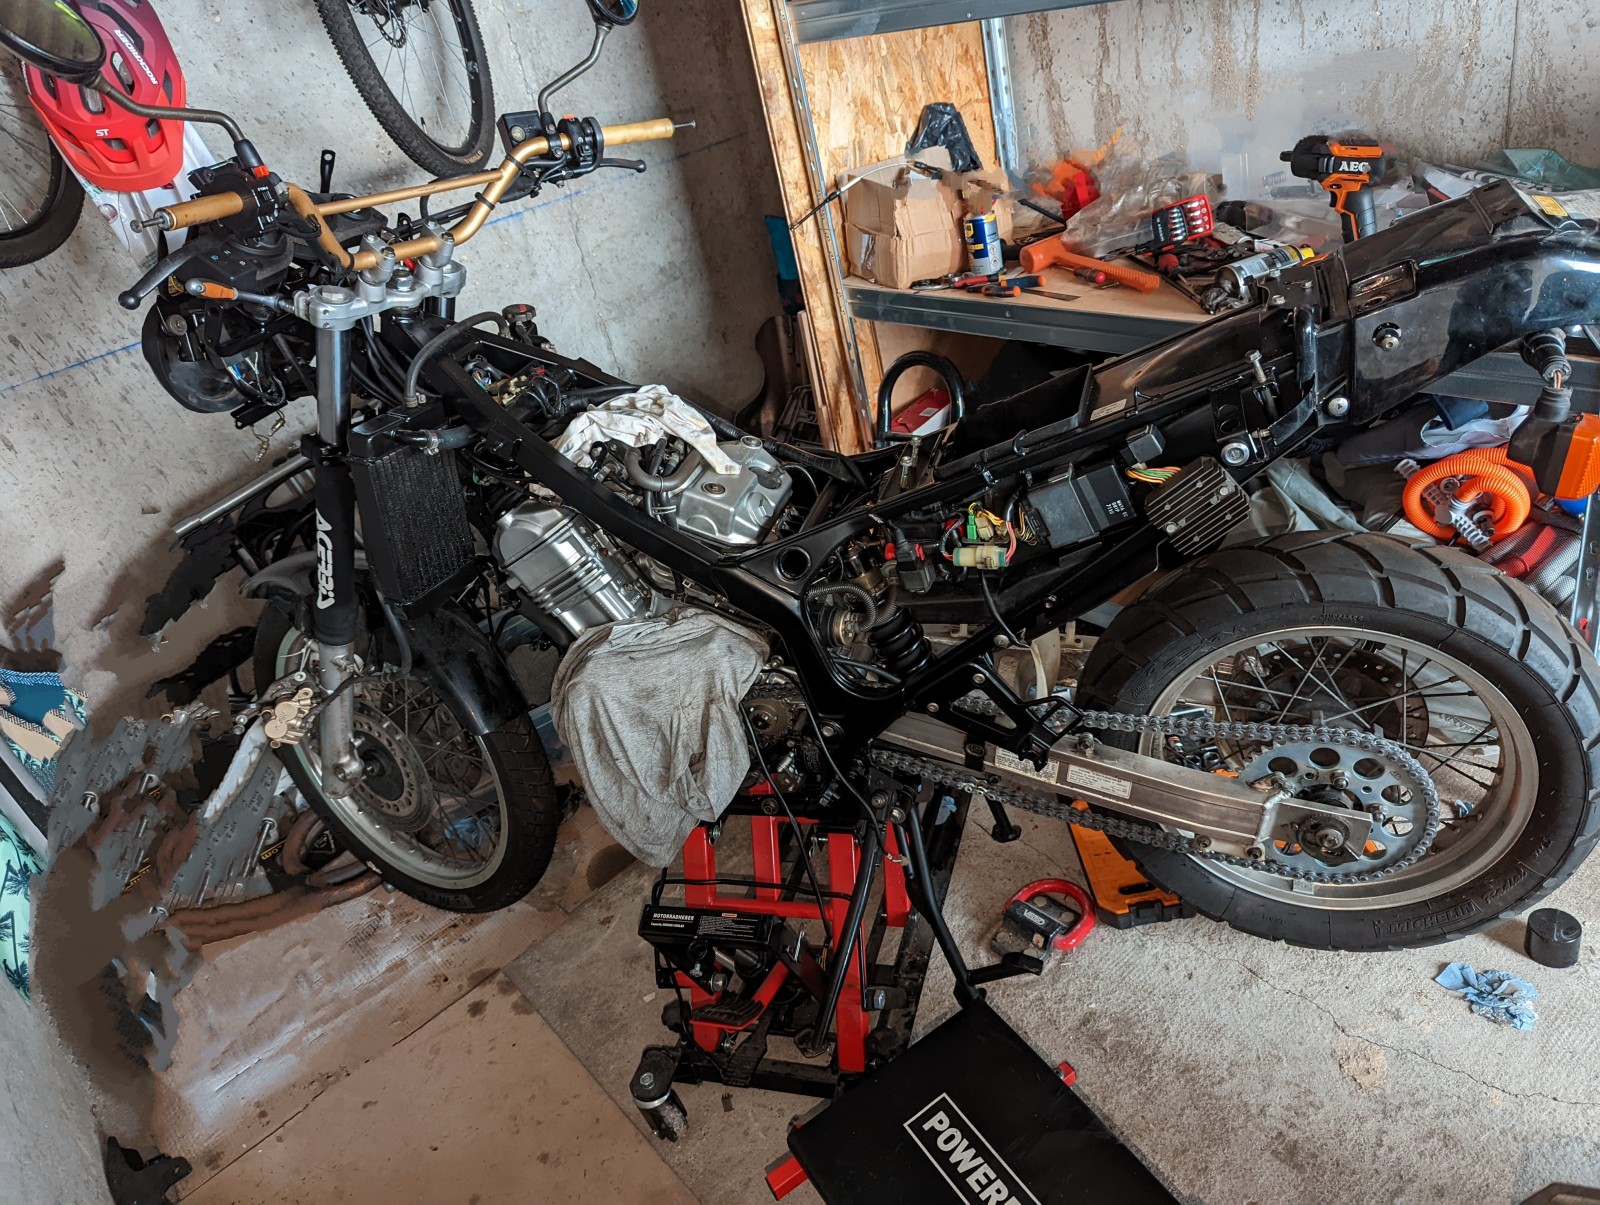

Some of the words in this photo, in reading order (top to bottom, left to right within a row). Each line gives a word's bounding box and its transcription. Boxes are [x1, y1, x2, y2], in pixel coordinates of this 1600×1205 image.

[114, 29, 159, 85] ROCKRIDER
[95, 128, 110, 137] ST
[1389, 901, 1476, 932] MICHELIN
